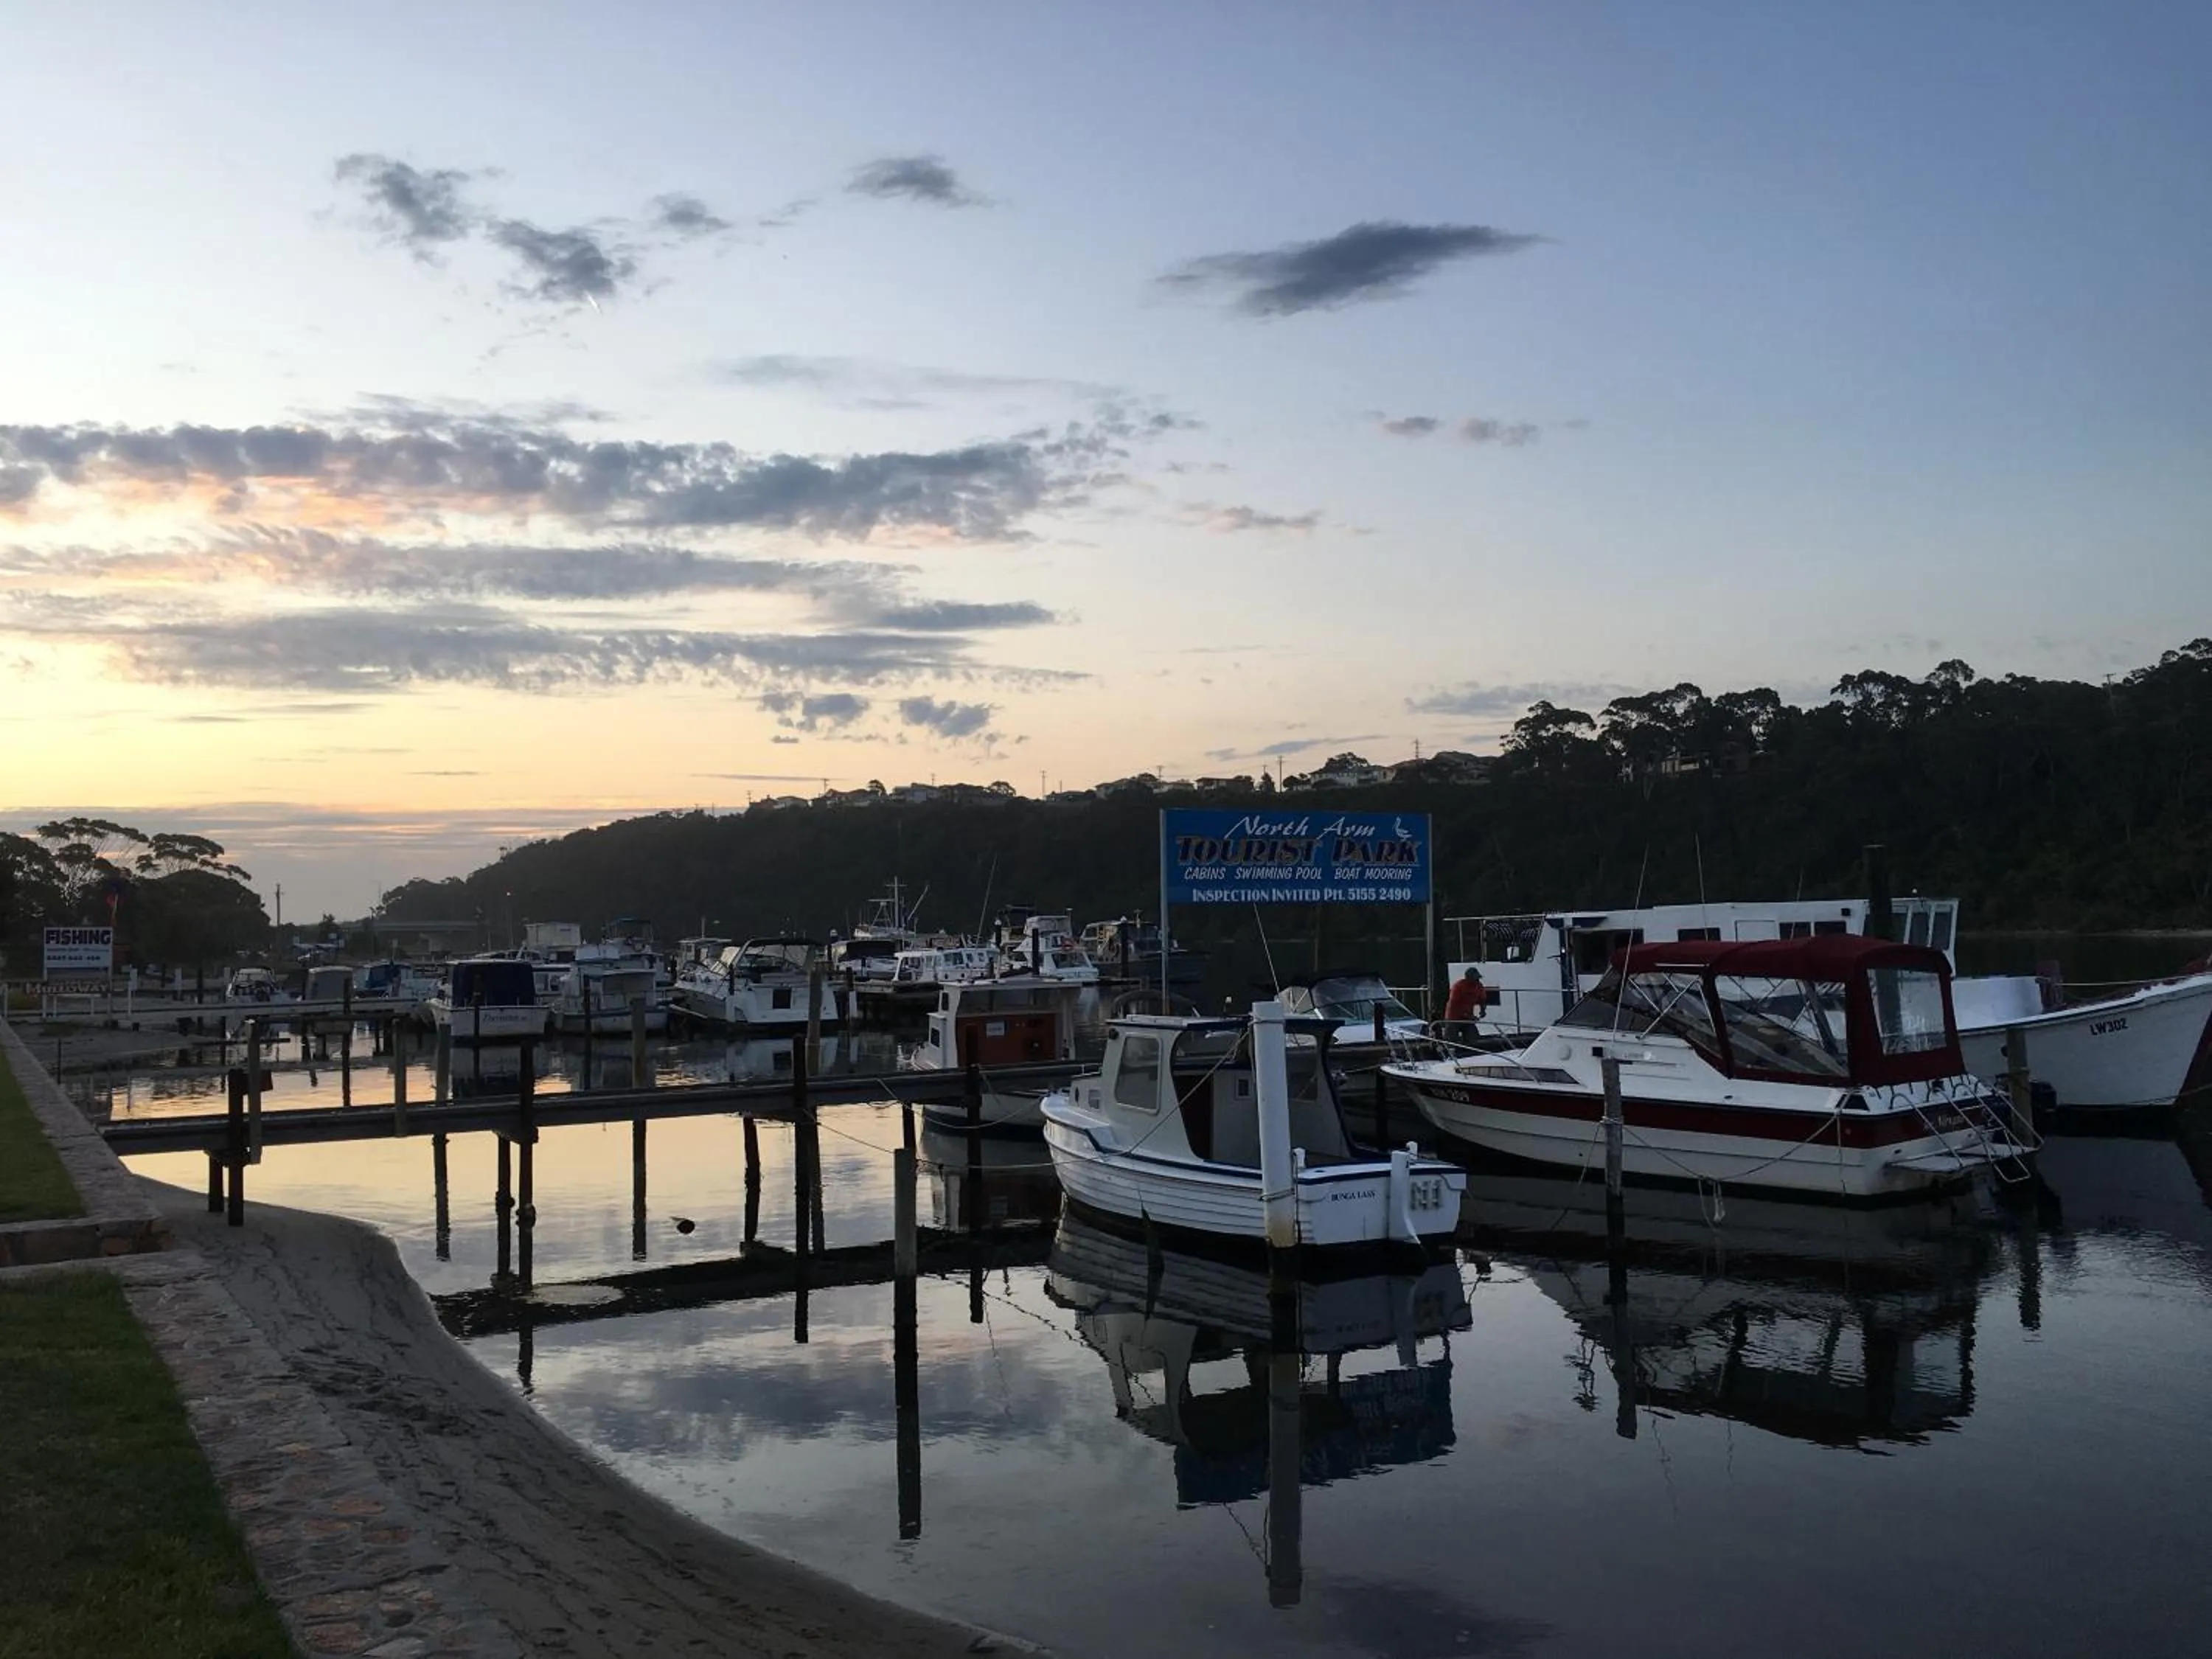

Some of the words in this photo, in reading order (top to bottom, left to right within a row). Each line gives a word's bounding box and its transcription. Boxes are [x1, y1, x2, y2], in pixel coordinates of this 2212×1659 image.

[1224, 815, 1310, 839] North
[1316, 816, 1376, 840] Arm
[1176, 835, 1324, 866] TOURIST
[1332, 838, 1422, 866] PARK
[1184, 866, 1226, 880] CABINS
[1234, 866, 1293, 880] SWIMMING
[1295, 867, 1322, 880] POOL
[1334, 867, 1362, 880] BOAT
[1364, 867, 1413, 880] MOORING
[1192, 888, 1270, 902] INSPECTION
[1272, 888, 1321, 902] INVITED
[1380, 888, 1412, 901] 2490
[46, 930, 111, 945] FISHING
[2089, 1018, 2129, 1036] LW302
